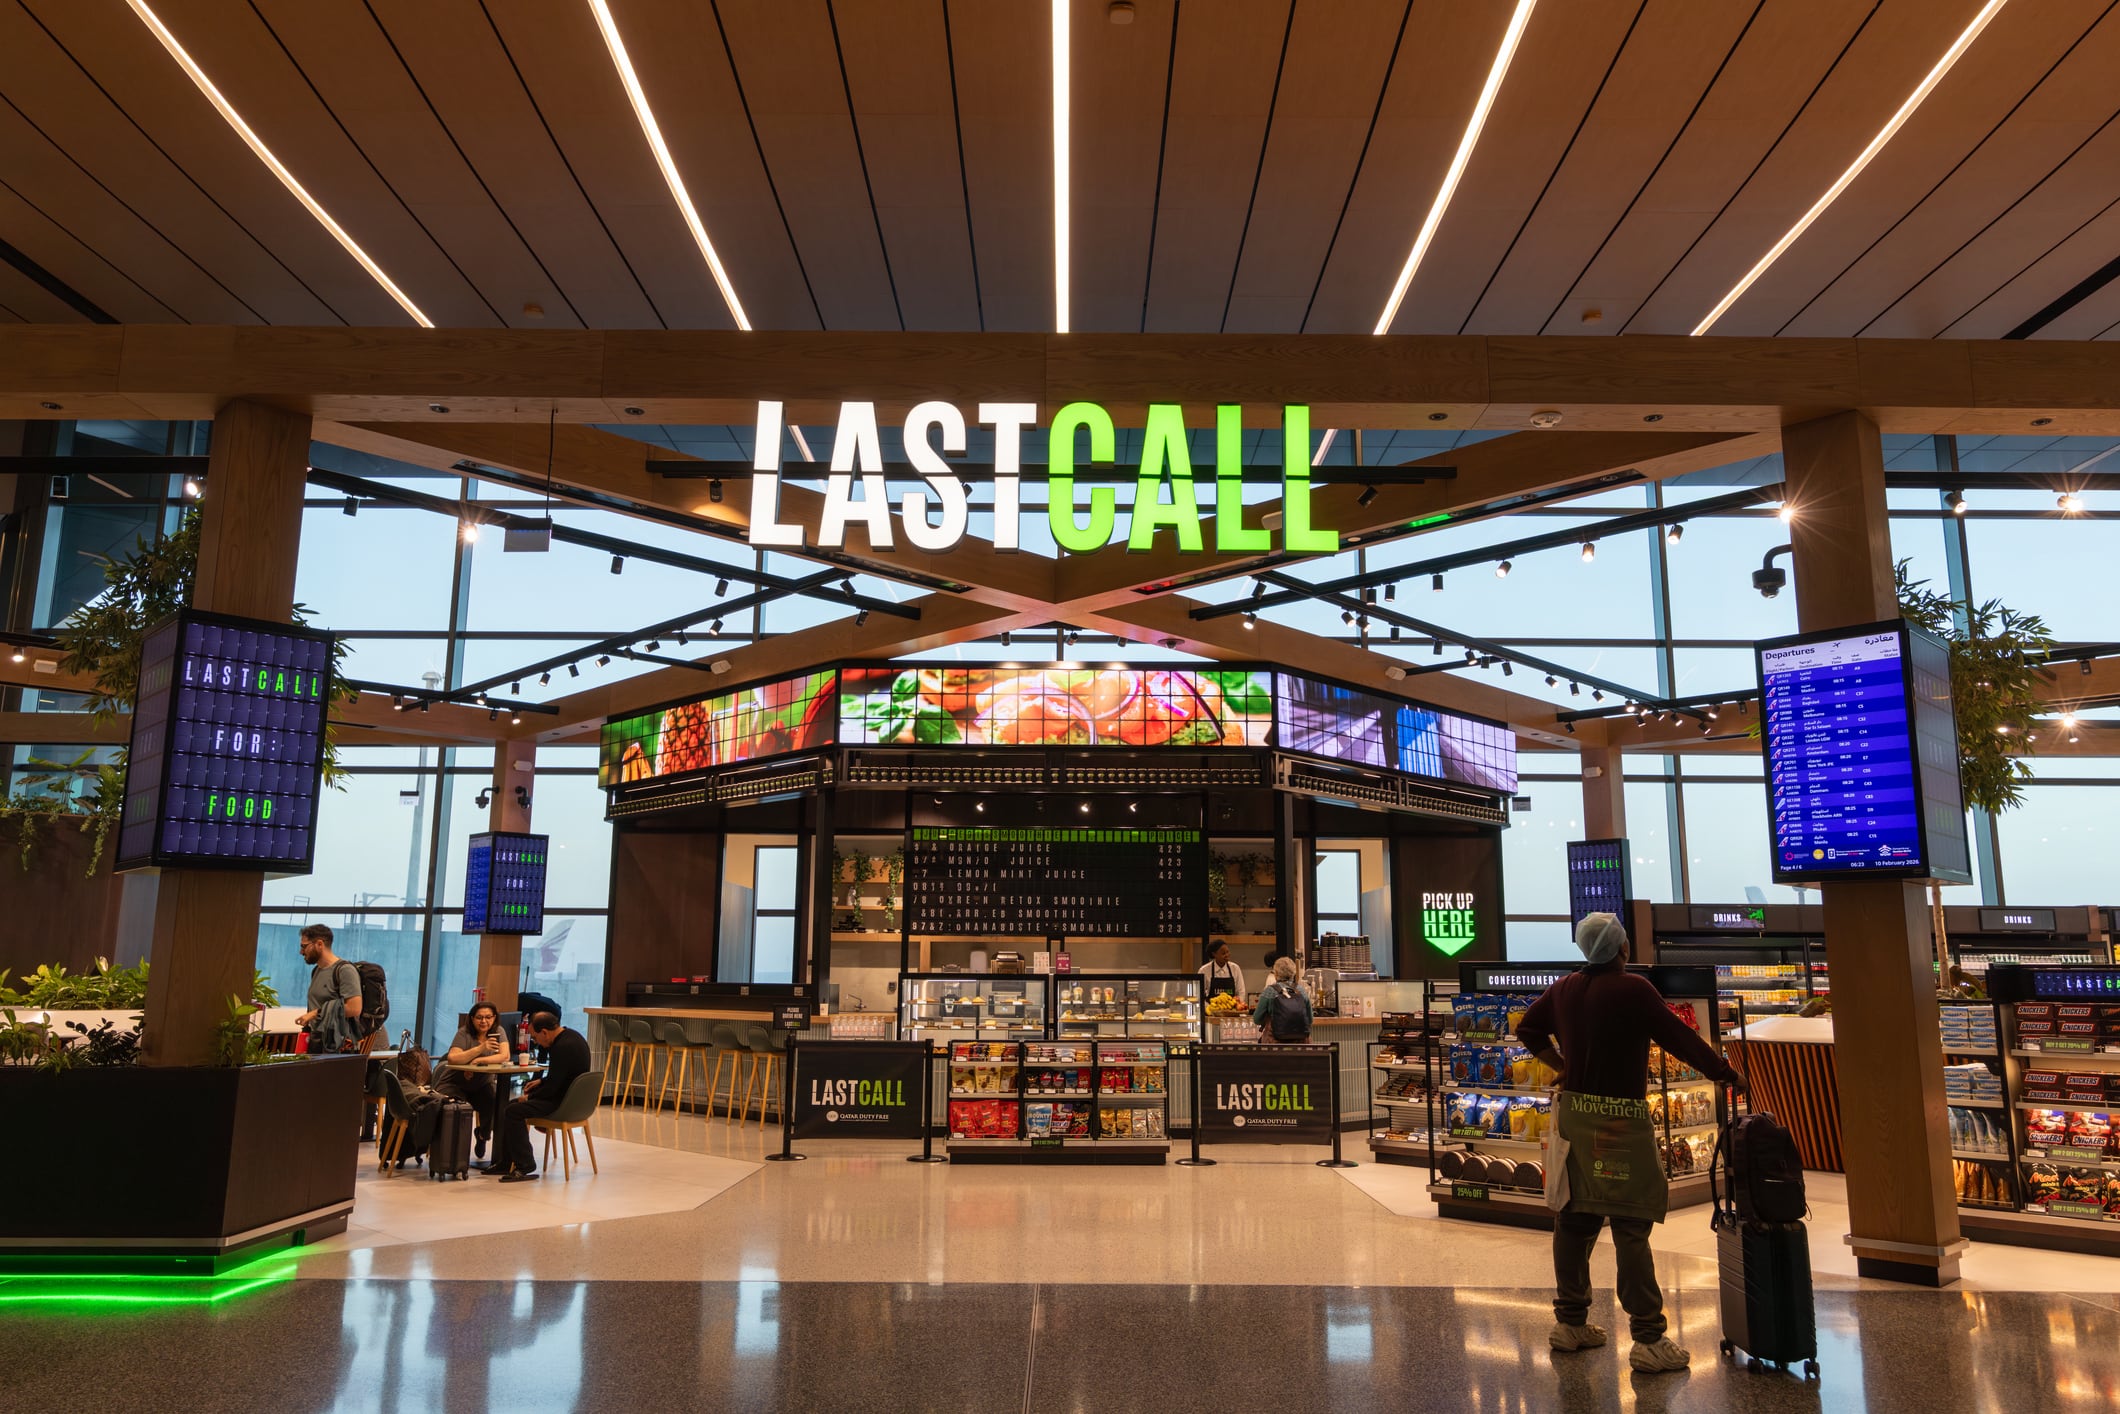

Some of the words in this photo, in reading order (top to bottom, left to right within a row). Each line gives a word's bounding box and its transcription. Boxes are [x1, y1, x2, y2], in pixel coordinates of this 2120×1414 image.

[749, 400, 1339, 553] LASTCALL
[1765, 647, 1815, 660] Departures
[184, 660, 319, 697] LASTCALL
[208, 795, 272, 819] FOOD
[1011, 844, 1050, 852] JUICE
[496, 852, 544, 863] LASTCALL
[1011, 857, 1050, 865] JUICE
[1571, 859, 1619, 870] LASTCALL
[949, 870, 989, 878] LEMON
[1000, 870, 1032, 878] MINT
[1045, 870, 1085, 879] JUICE
[1423, 893, 1453, 909] PICK
[1457, 893, 1473, 909] UP
[504, 905, 528, 915] FOOD
[1018, 909, 1084, 919] SMOOTHIE
[1713, 913, 1741, 922] DRINKS
[2004, 916, 2032, 924] DRINKS
[1424, 911, 1475, 937] HERE
[1489, 976, 1559, 985] CONFECTIONERY
[2027, 1074, 2055, 1083] SNICKERS
[811, 1079, 906, 1106] LASTCALL
[1217, 1084, 1313, 1110] LASTCALL
[1571, 1096, 1646, 1119] Movement
[2030, 1133, 2062, 1142] SNICKERS
[2073, 1136, 2106, 1144] SNICKERS
[1457, 1188, 1472, 1196] 25%
[1472, 1190, 1483, 1198] OFF
